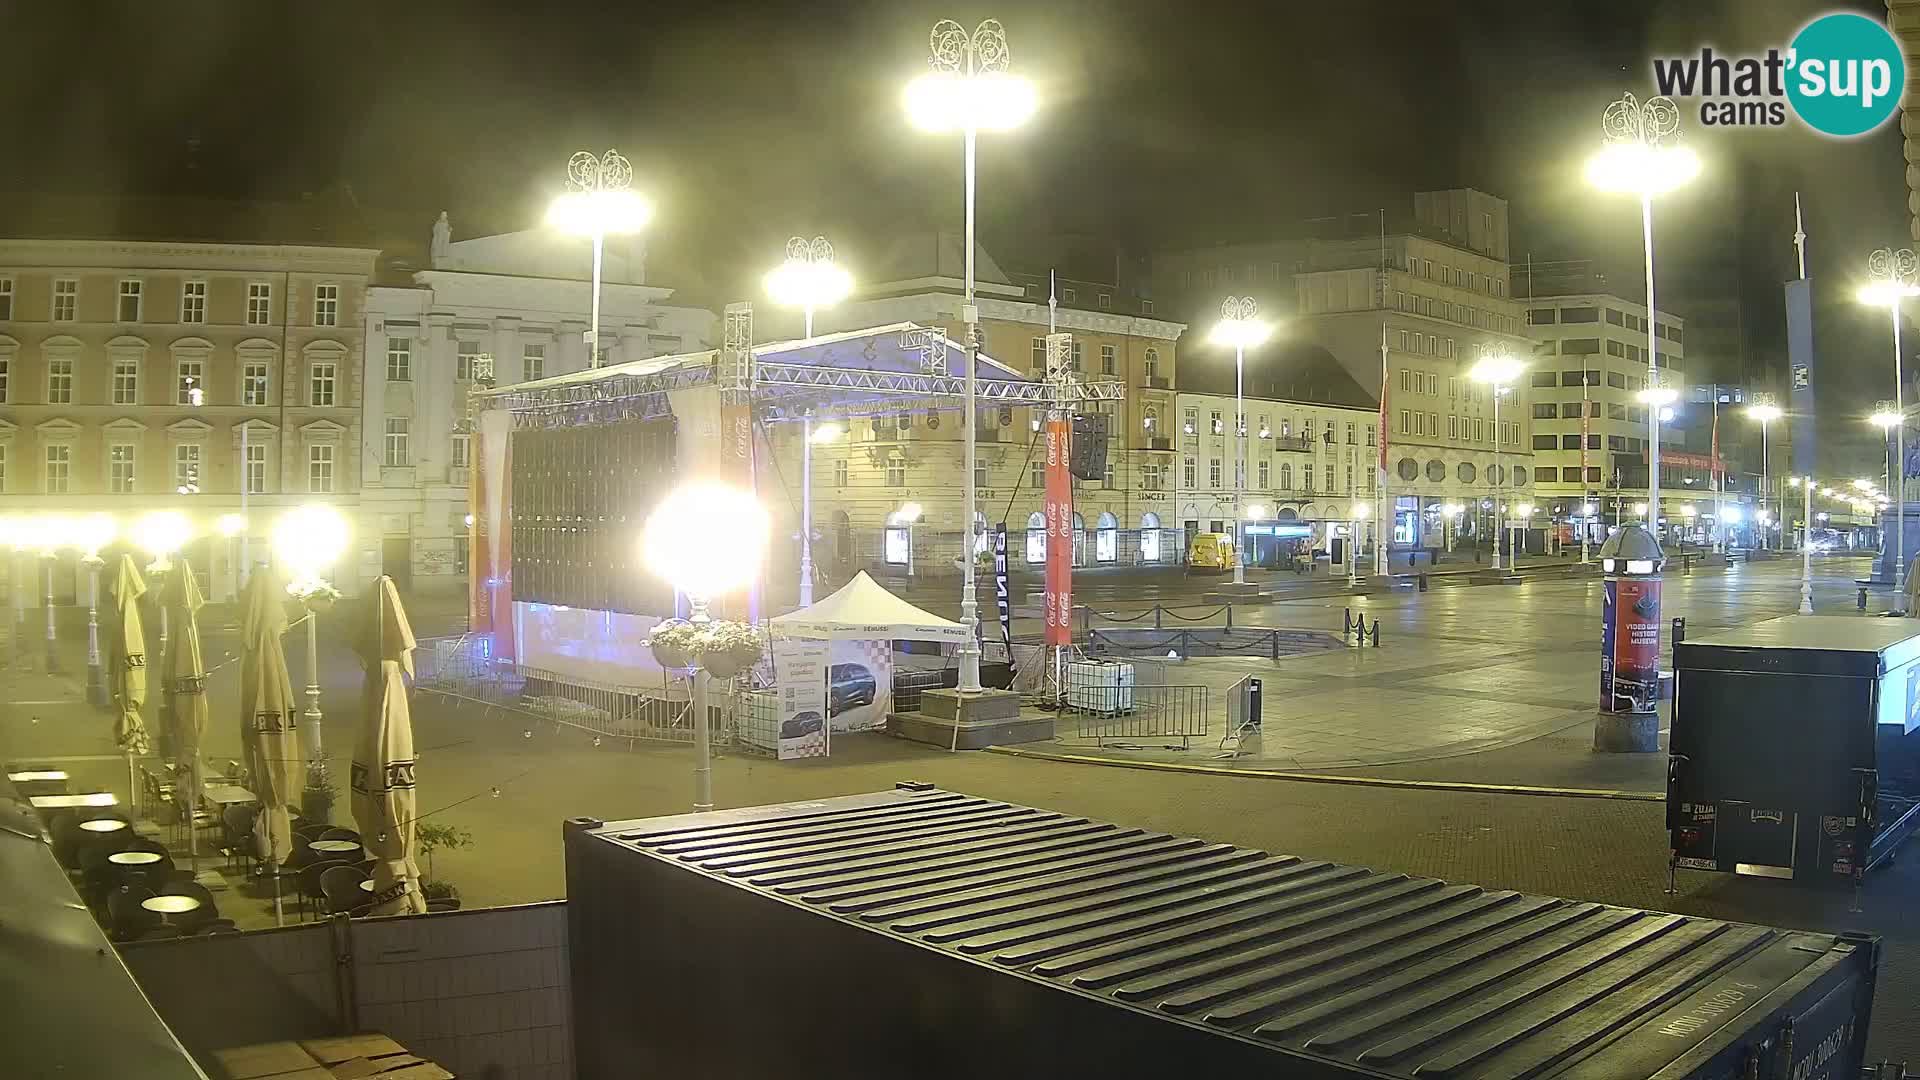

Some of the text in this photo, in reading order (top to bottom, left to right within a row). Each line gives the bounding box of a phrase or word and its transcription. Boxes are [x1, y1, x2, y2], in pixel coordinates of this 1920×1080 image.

[1138, 492, 1166, 502] SINGER
[1625, 623, 1646, 631] VIDEO
[1631, 630, 1657, 638] HISTORY
[1631, 637, 1657, 646] MUSEUM
